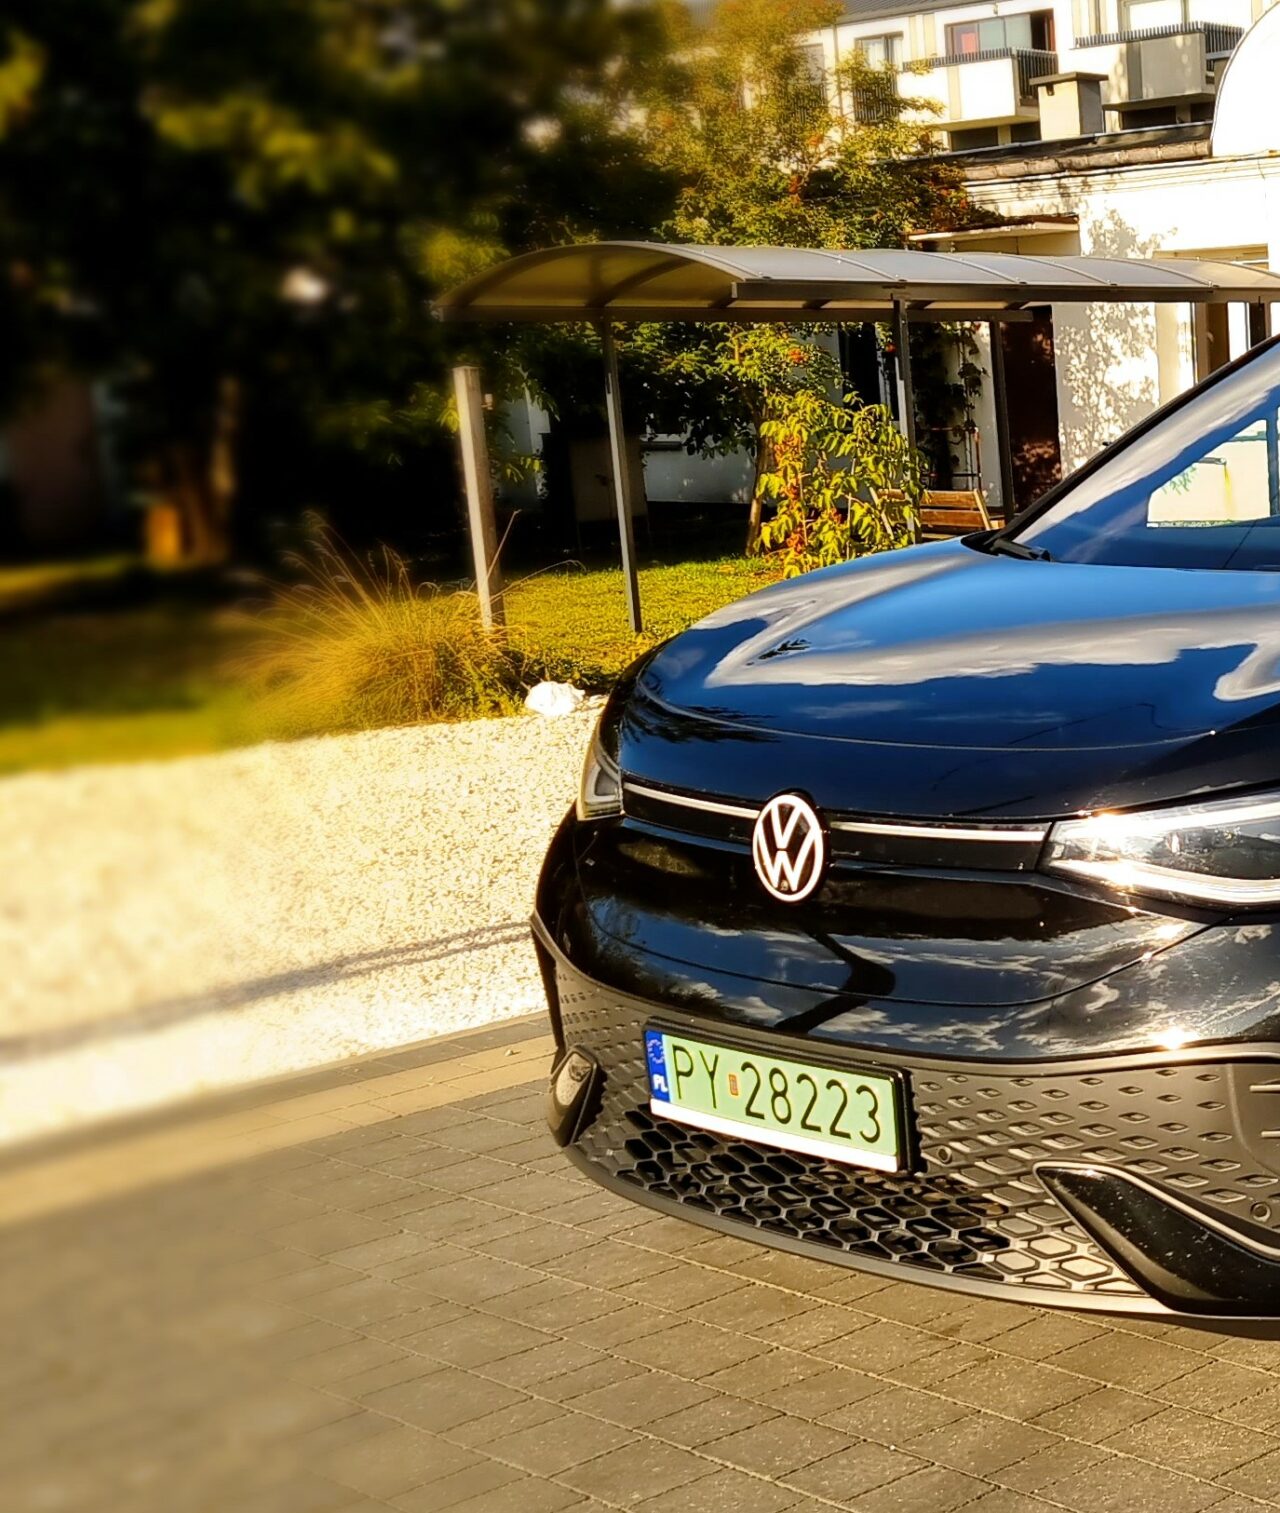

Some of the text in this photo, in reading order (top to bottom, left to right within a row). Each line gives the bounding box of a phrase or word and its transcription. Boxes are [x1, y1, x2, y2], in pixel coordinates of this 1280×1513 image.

[753, 794, 823, 901] VW
[653, 1074, 668, 1093] PL
[672, 1044, 881, 1144] PY 28223
